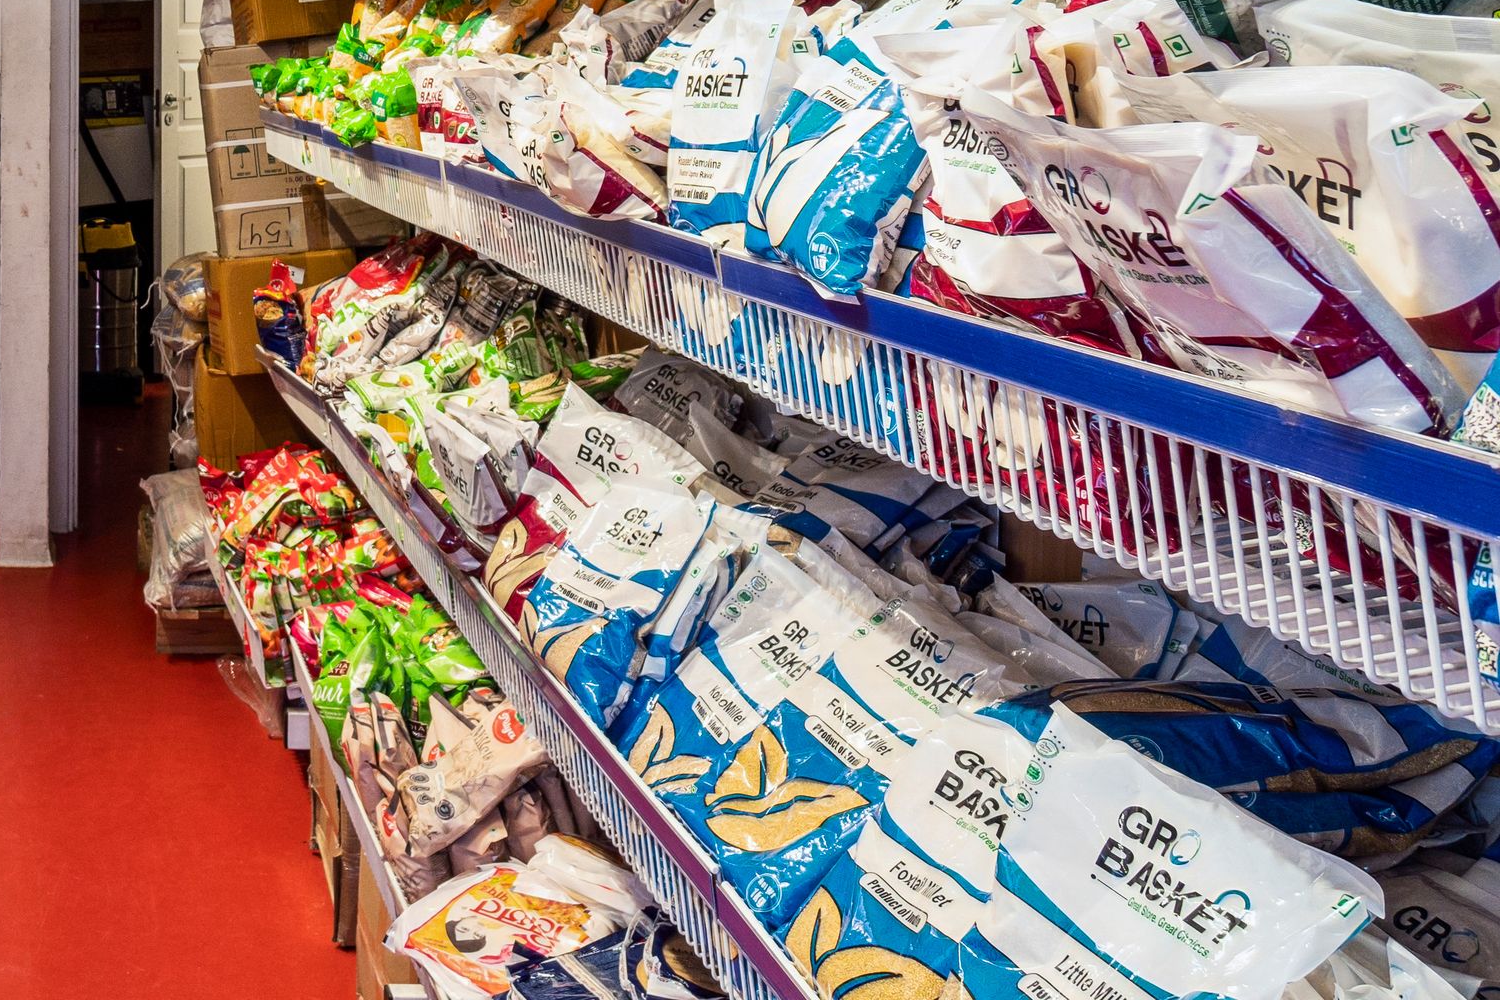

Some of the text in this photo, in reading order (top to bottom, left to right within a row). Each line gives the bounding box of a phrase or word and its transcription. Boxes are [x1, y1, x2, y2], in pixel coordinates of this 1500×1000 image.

[686, 74, 748, 98] BASKET
[1045, 163, 1112, 215] GRO
[585, 426, 633, 460] GRO
[769, 482, 794, 497] Kodo
[758, 636, 812, 682] BASKET
[909, 626, 952, 666] GRO
[887, 649, 973, 706] BASKET
[812, 723, 837, 748] Product
[828, 698, 861, 734] Foxtail
[1119, 805, 1201, 867] GRO
[867, 877, 900, 910] Product
[1096, 840, 1250, 946] BASKET
[1393, 905, 1481, 965] GRO
[1054, 953, 1095, 991] Little
